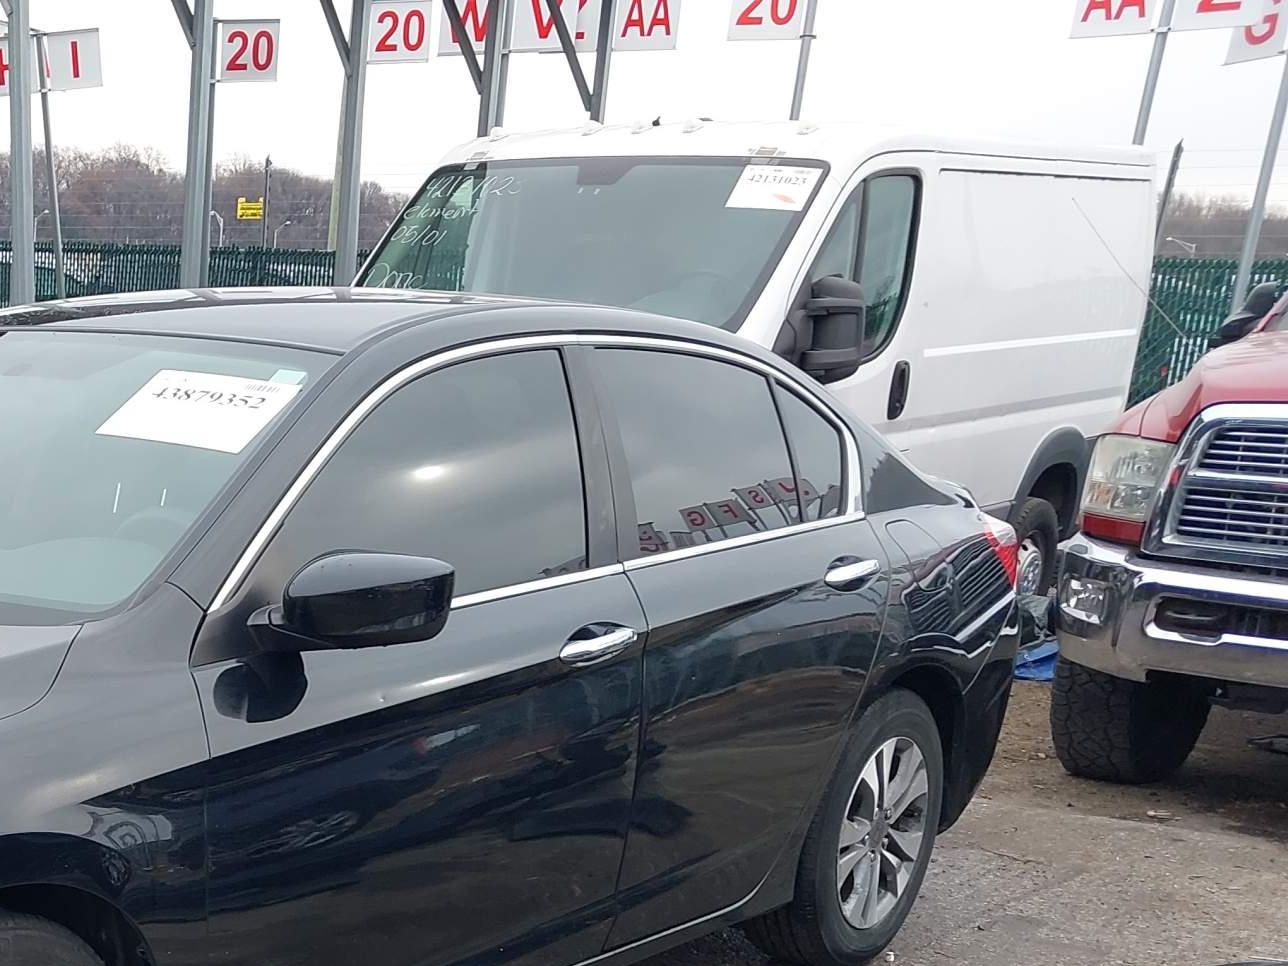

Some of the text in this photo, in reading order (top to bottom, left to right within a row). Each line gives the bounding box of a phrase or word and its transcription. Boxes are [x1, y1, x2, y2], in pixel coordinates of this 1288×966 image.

[374, 9, 426, 52] 20
[620, 0, 671, 38] AA
[70, 41, 79, 78] I
[225, 30, 275, 71] 20
[391, 225, 448, 246] 05/01
[152, 386, 266, 409] 43879352
